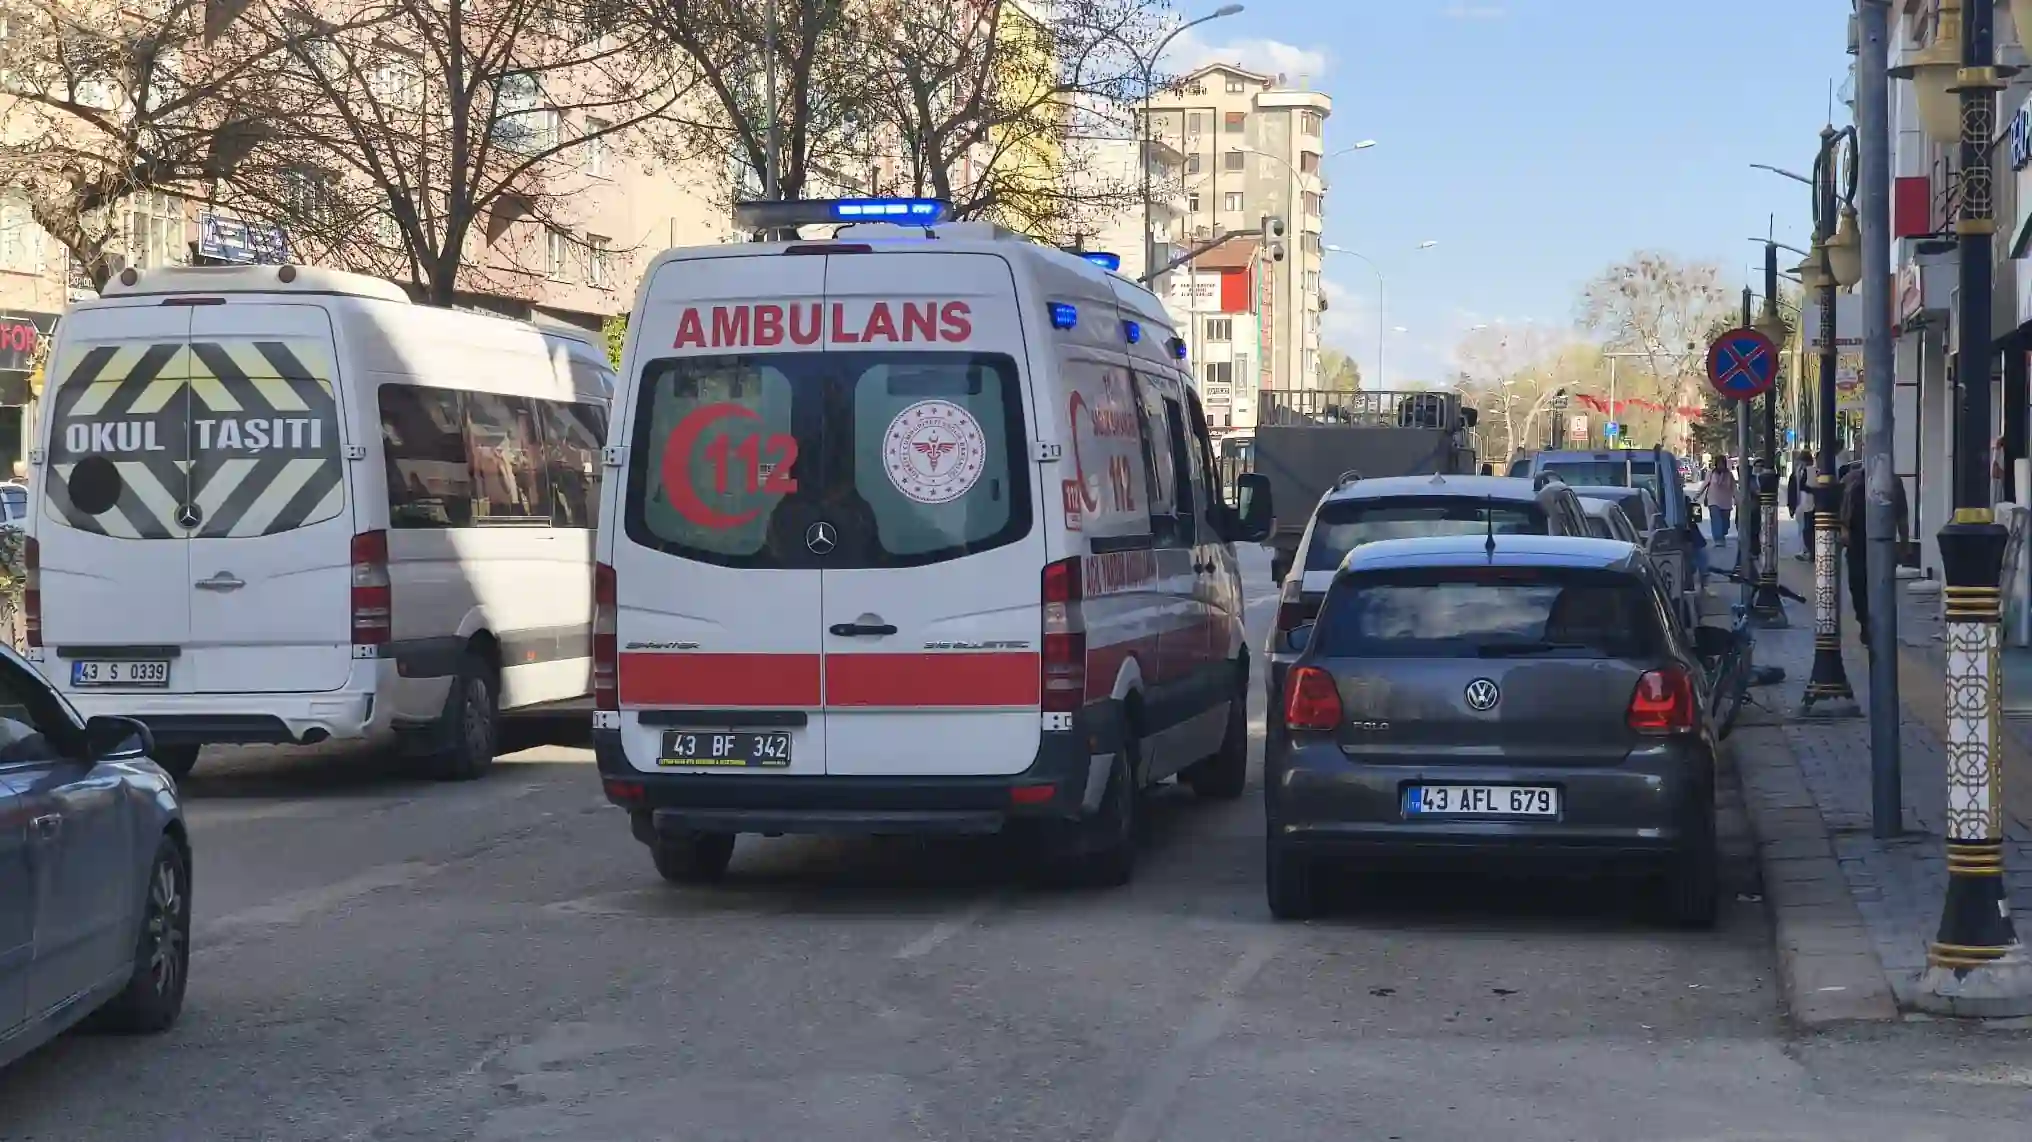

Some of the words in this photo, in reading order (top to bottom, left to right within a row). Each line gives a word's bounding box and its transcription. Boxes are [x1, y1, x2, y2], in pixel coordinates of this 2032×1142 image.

[673, 301, 972, 349] AMBULANS
[66, 421, 166, 453] OKUL
[195, 418, 322, 453] TAŞITI
[705, 431, 799, 495] 112
[1066, 484, 1081, 510] 112
[1108, 455, 1135, 512] 112
[81, 664, 98, 680] 43
[110, 664, 119, 680] S
[130, 664, 165, 680] 0339
[673, 734, 697, 756] 43
[712, 735, 736, 757] BF
[753, 735, 787, 758] 342
[1422, 789, 1448, 810] 43
[1460, 788, 1499, 811] AFL
[1510, 789, 1550, 812] 679
